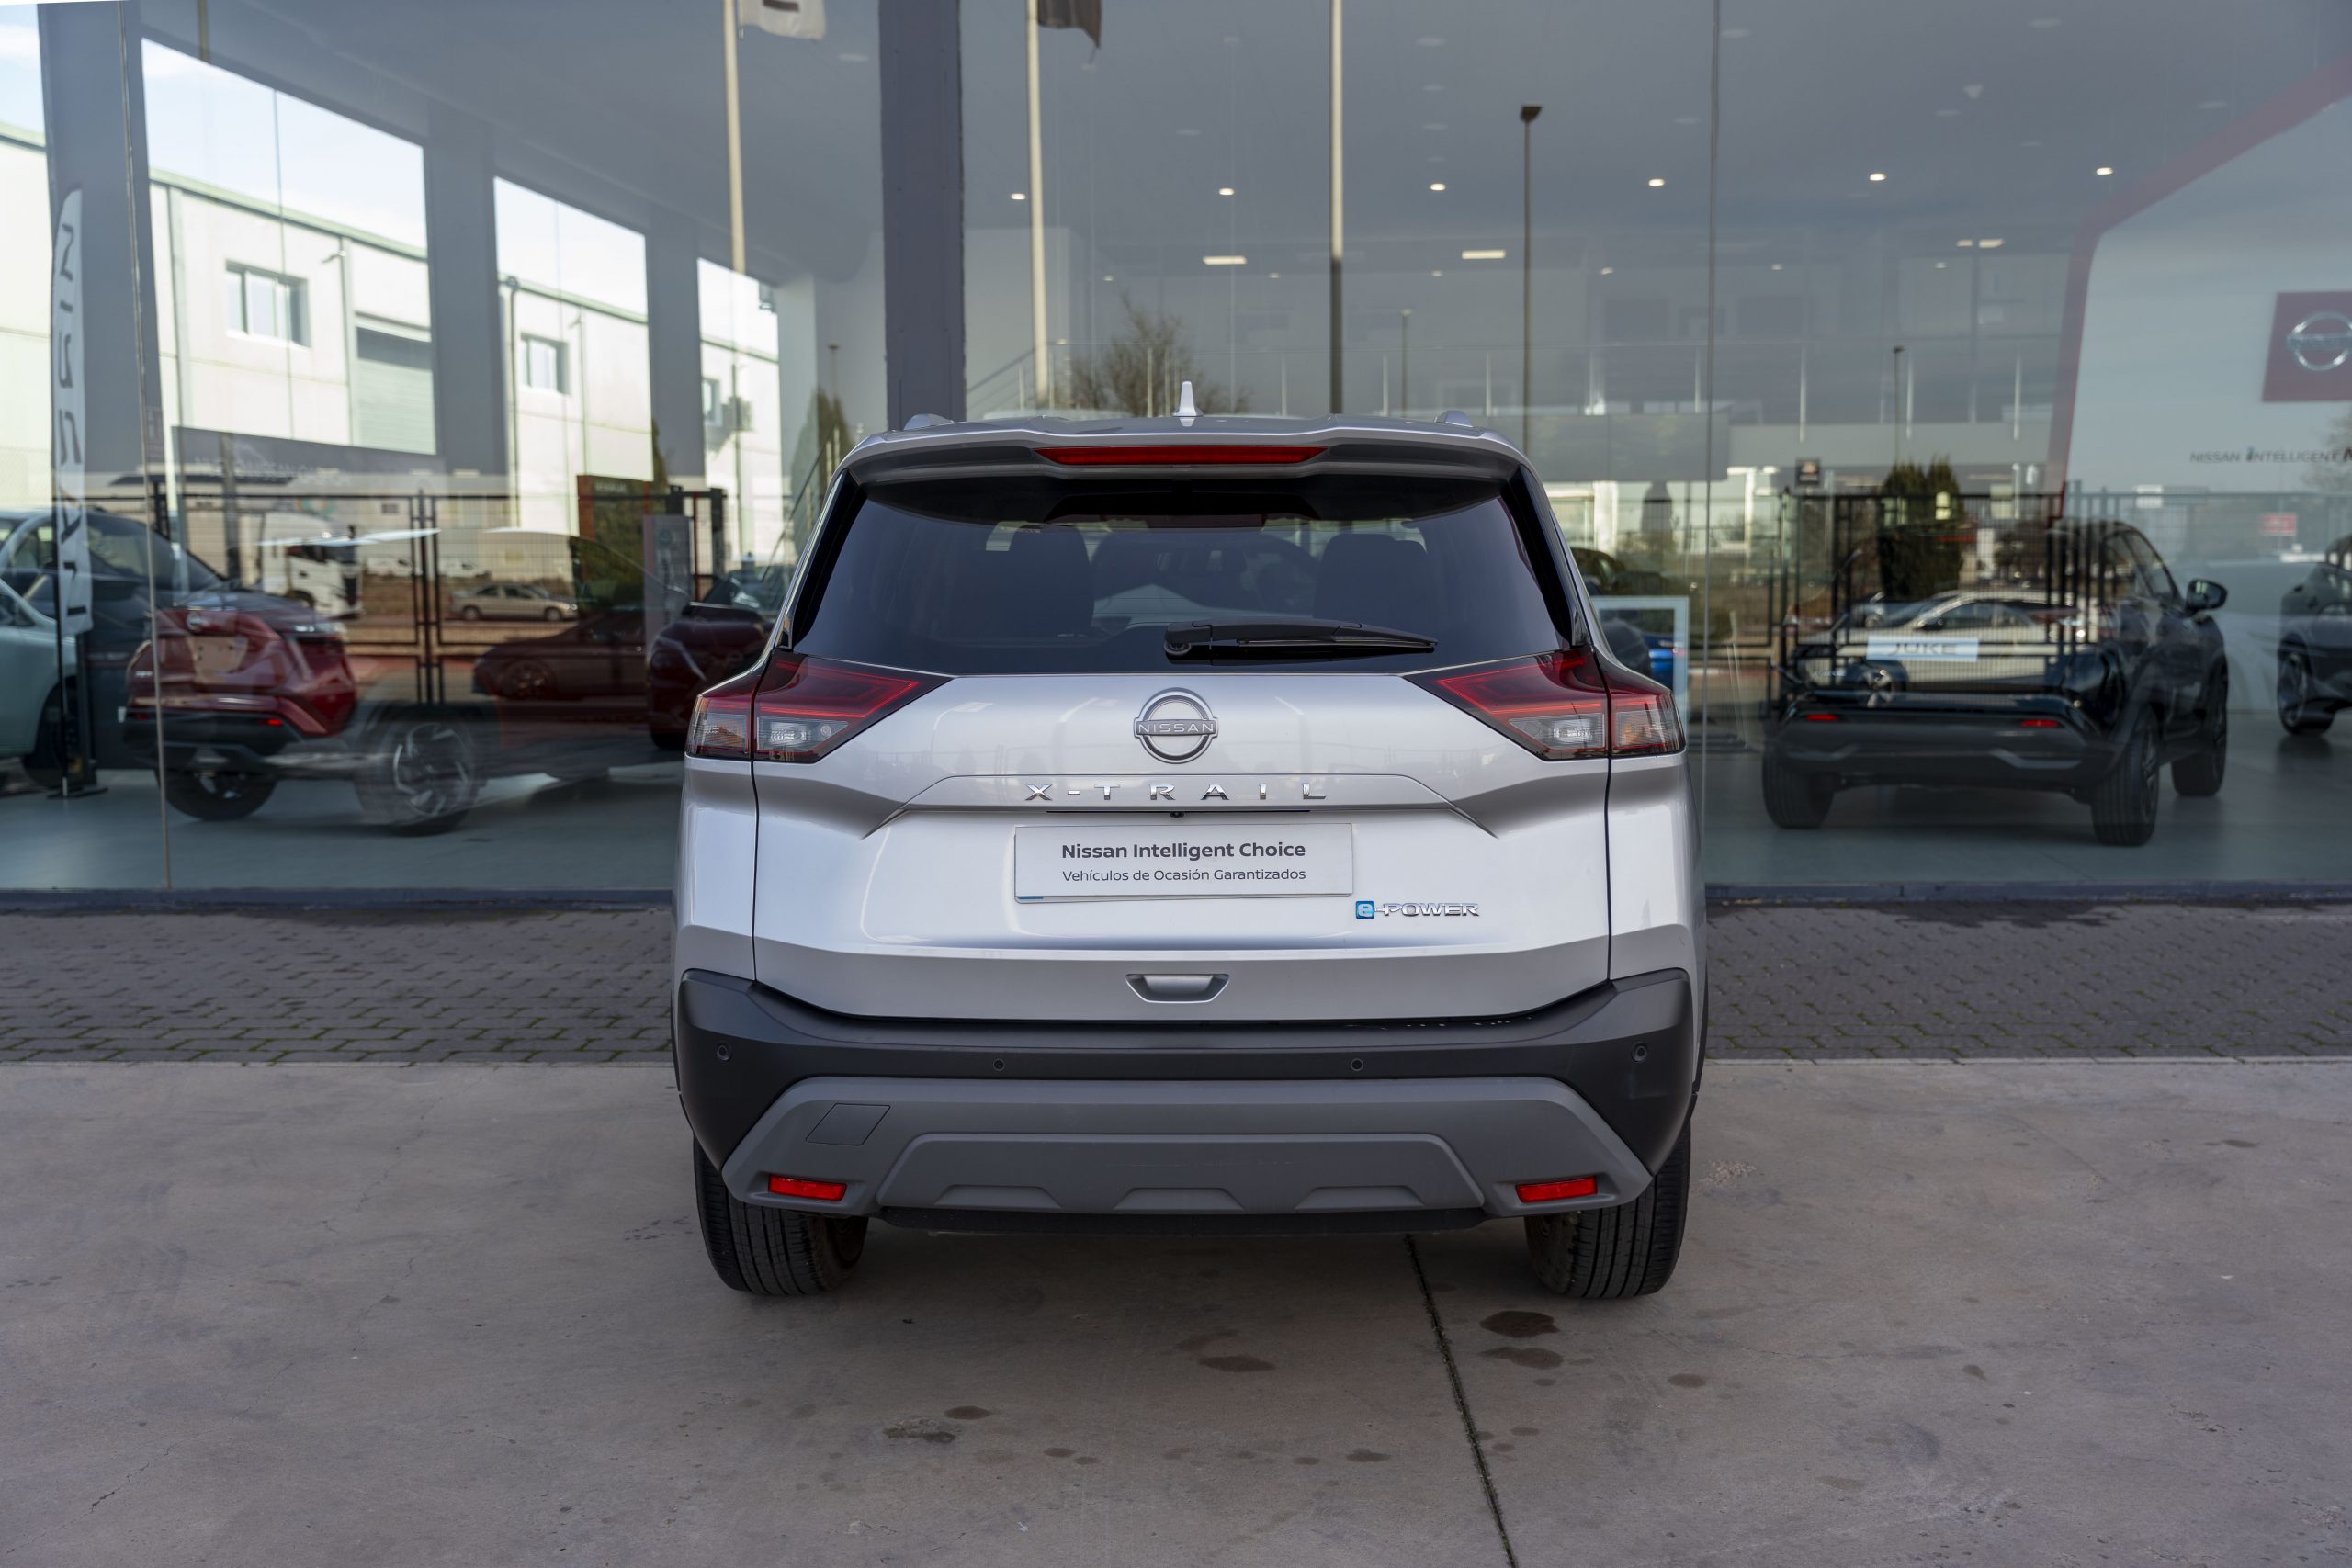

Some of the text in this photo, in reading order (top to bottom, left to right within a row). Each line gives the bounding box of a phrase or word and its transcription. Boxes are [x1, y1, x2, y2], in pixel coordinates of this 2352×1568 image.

[2190, 450, 2240, 462] NISSAN
[1888, 642, 1957, 656] JUKE
[1138, 723, 1214, 733] NISSAN
[1025, 783, 1327, 801] X-TRAIL
[1062, 842, 1306, 861] Nissan Intelligent Choice
[1062, 868, 1306, 882] Vehículos de Ocasión Garantizados
[1356, 900, 1480, 919] e-POWER
